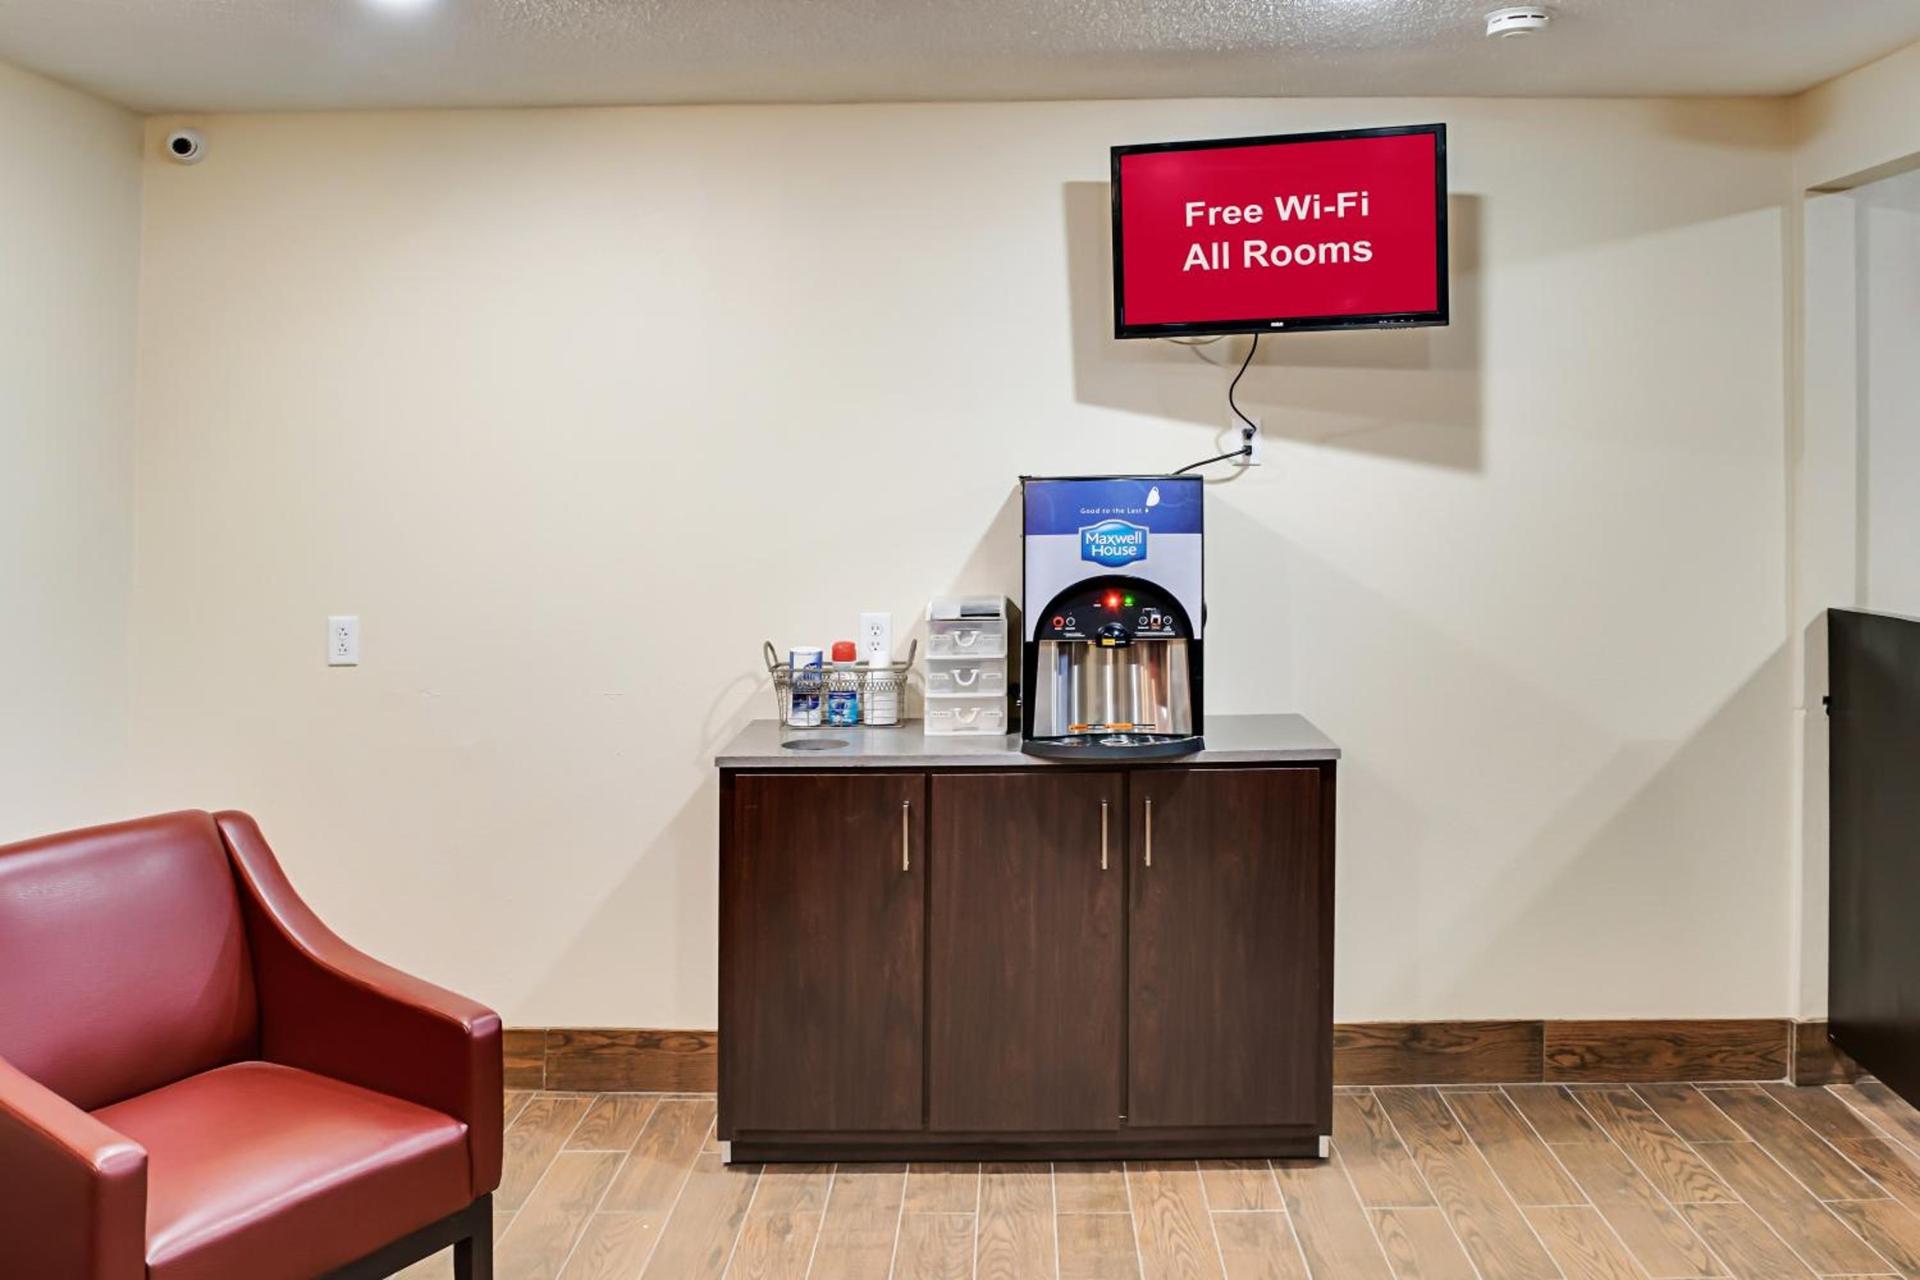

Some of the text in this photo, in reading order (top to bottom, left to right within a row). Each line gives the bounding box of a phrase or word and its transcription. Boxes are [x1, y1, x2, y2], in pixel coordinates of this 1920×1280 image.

[1185, 191, 1369, 227] Free Wi-Fi
[1182, 239, 1373, 271] All Rooms
[1086, 531, 1142, 545] Maxwell
[1091, 544, 1137, 557] House
